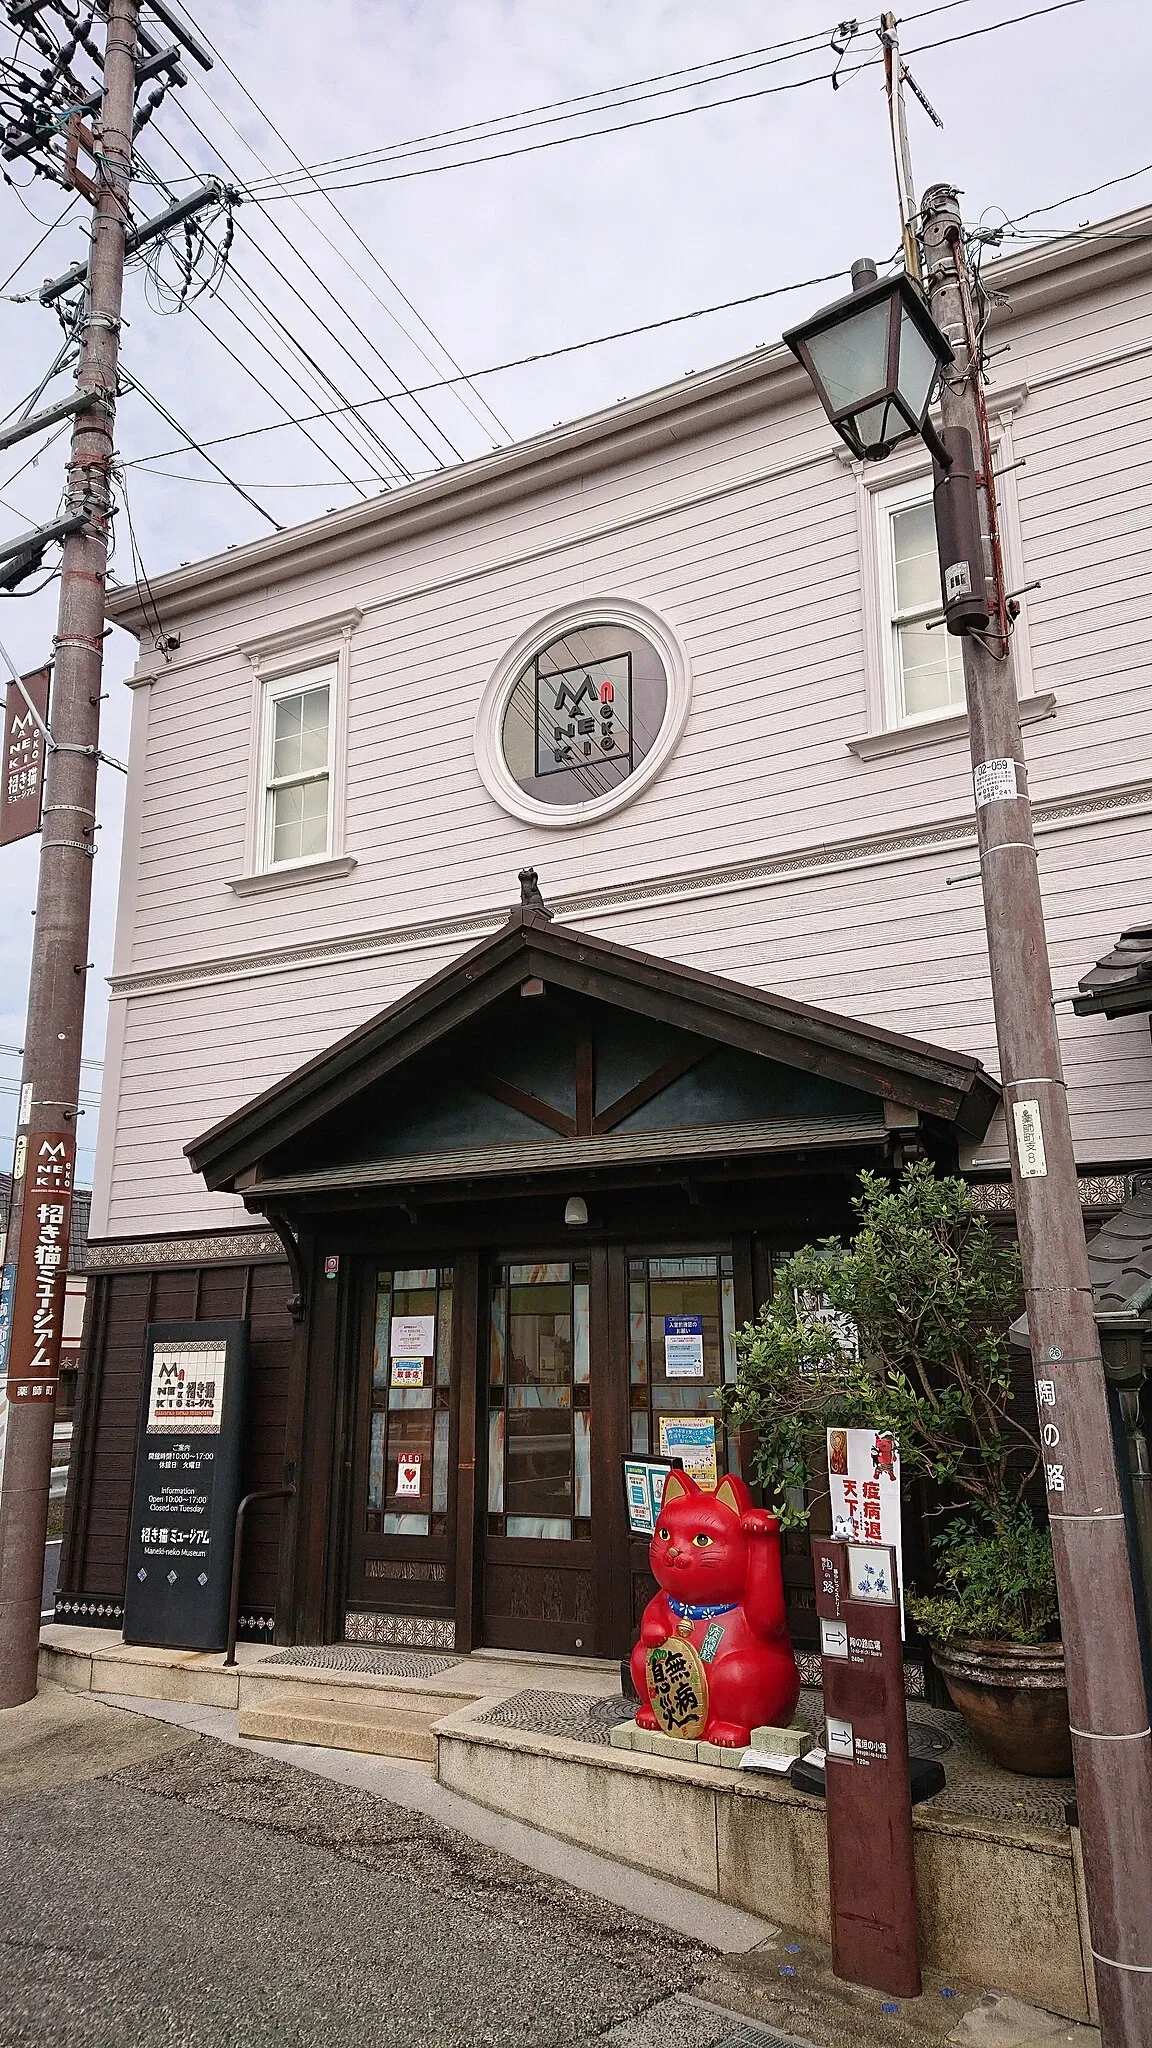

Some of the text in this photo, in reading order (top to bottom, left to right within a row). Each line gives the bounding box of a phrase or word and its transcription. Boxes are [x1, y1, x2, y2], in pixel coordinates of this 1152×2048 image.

[978, 760, 1008, 776] 02-059
[8, 766, 38, 795] 招き猫
[7, 788, 36, 804] ミュージアム
[30, 1203, 64, 1366] 招き猫ミュージアム
[186, 1381, 215, 1398] 招き猫
[182, 1461, 201, 1469] 火曜日
[401, 1455, 420, 1463] AED
[148, 1495, 164, 1503] Open
[161, 1487, 195, 1495] Information
[150, 1504, 169, 1512] Closed
[179, 1505, 205, 1514] Tuesday
[862, 1481, 883, 1545] 疫病退
[141, 1528, 210, 1544] 招き猫 ミュージアム
[144, 1547, 206, 1557] Maneki-neko Museum
